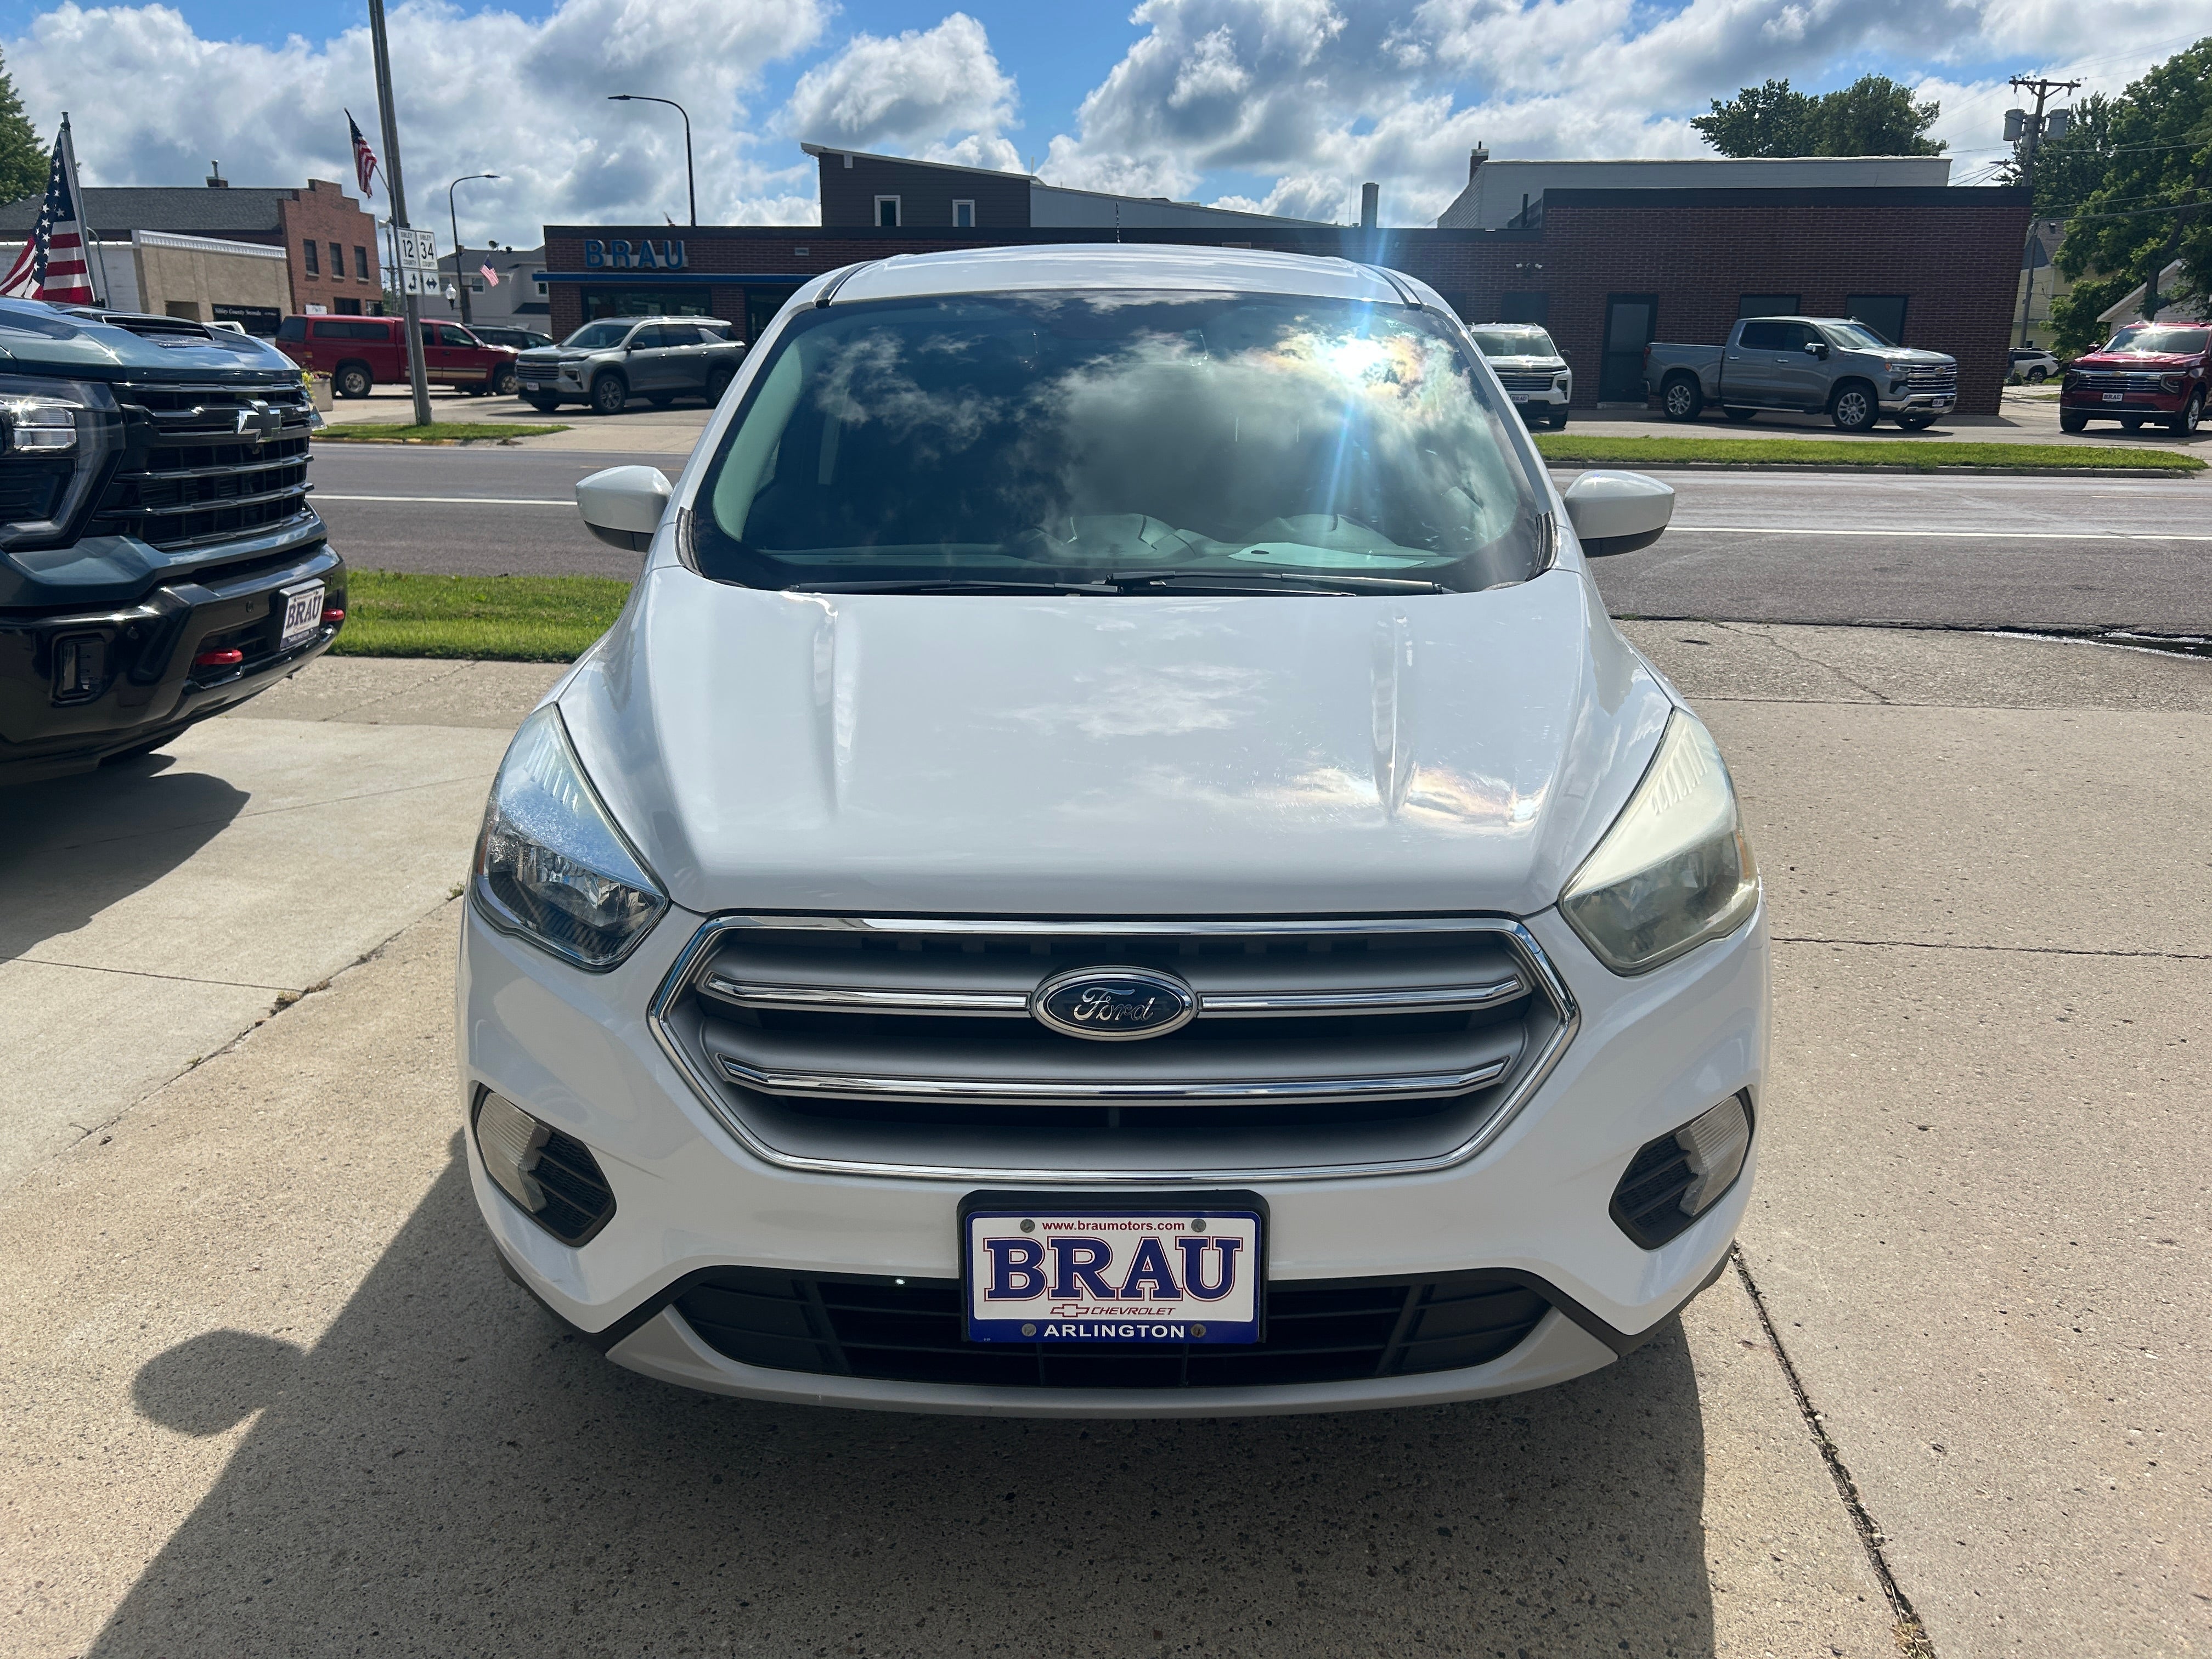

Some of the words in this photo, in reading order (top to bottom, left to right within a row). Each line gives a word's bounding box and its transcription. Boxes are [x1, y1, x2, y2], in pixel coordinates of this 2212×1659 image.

[402, 240, 414, 258] 12
[420, 241, 434, 260] 34
[584, 239, 685, 269] BRAU
[285, 595, 323, 629] BRAU
[1074, 987, 1156, 1021] Ford
[1042, 1220, 1185, 1231] www.braumotors.com
[983, 1235, 1244, 1302] BRAU
[1090, 1307, 1176, 1315] CHEVROLET
[1043, 1324, 1185, 1338] ARLINGTON
